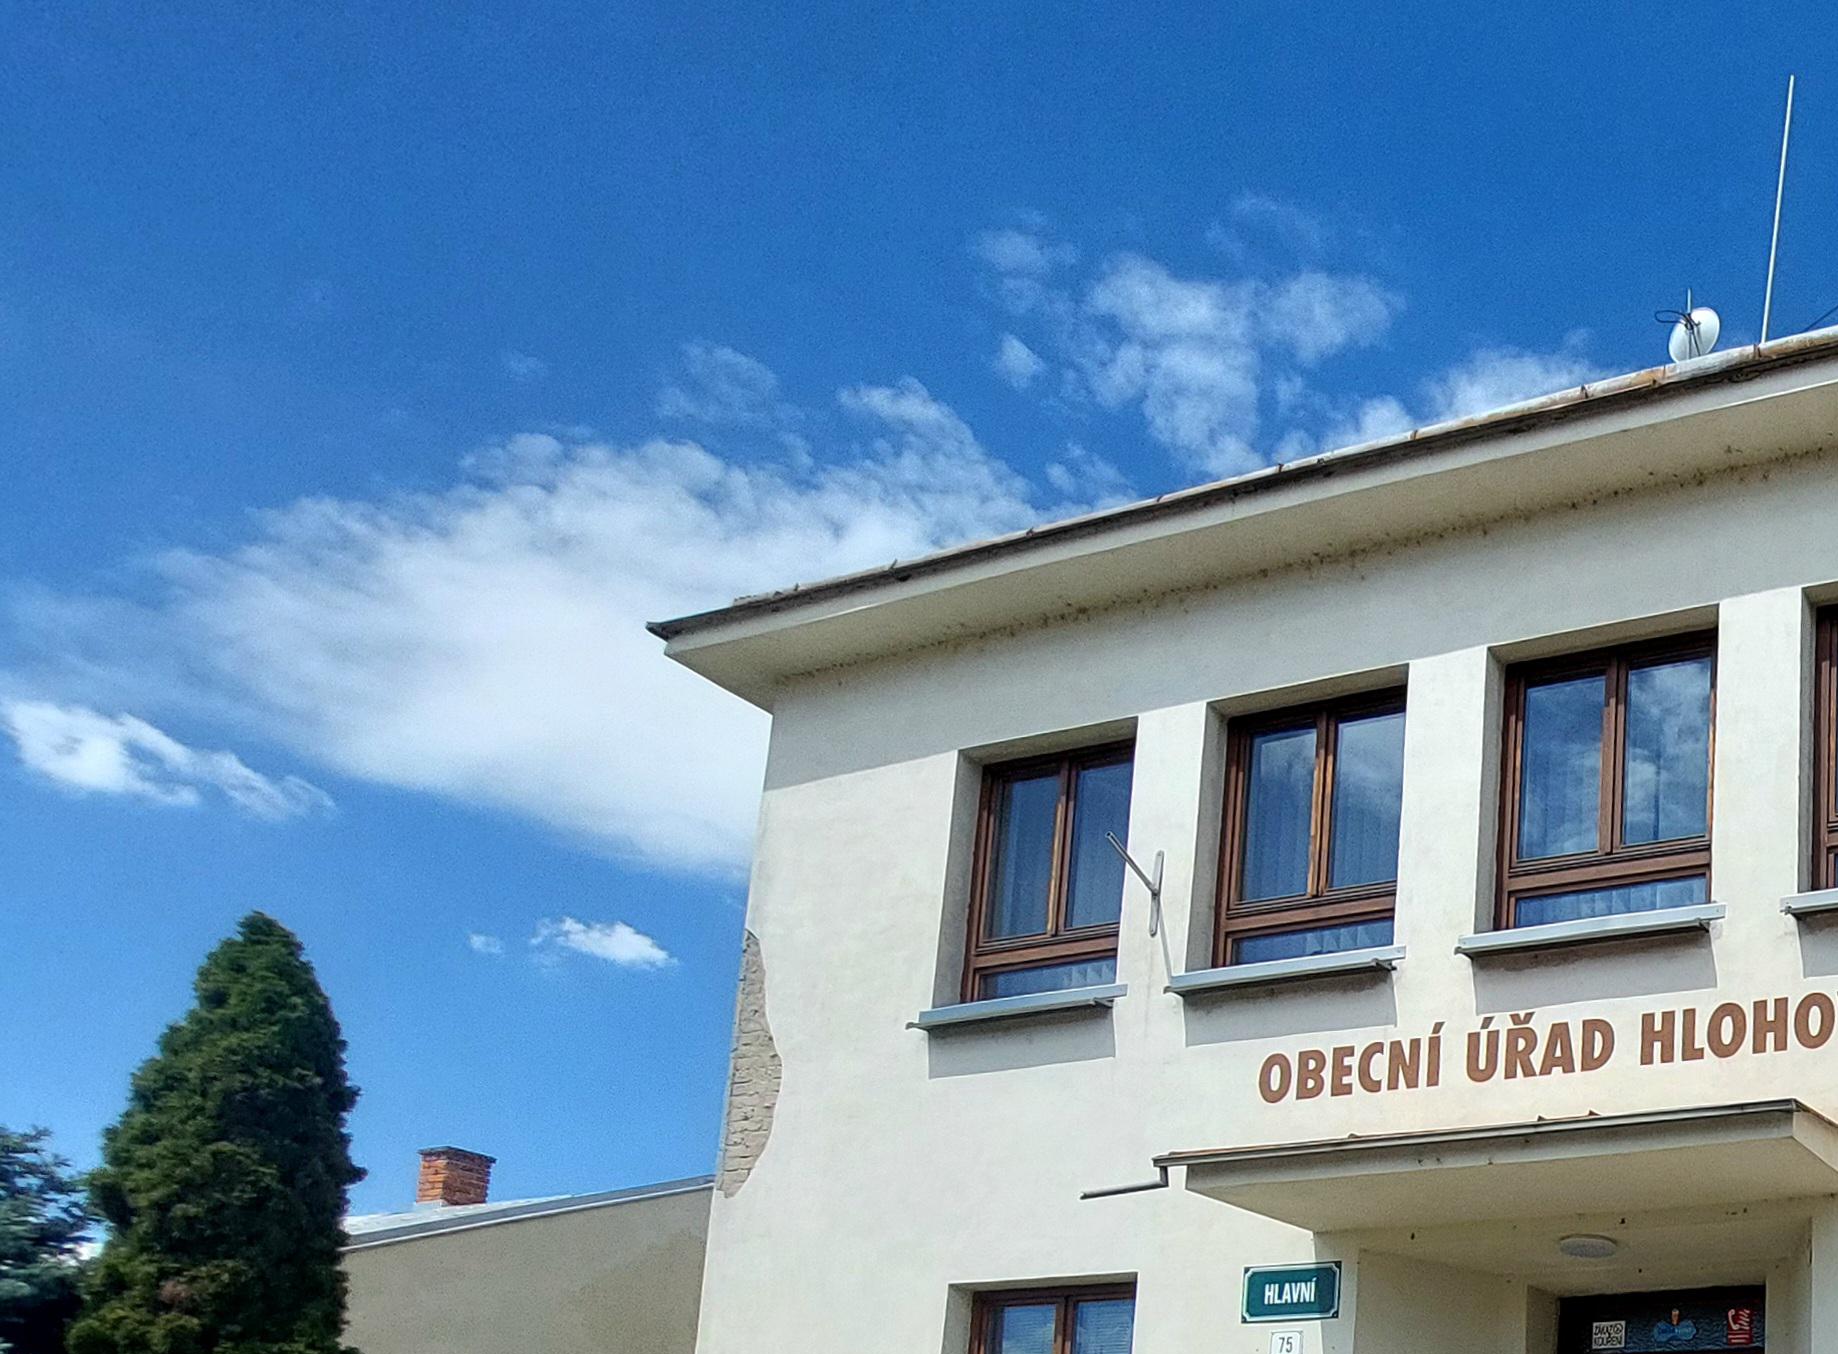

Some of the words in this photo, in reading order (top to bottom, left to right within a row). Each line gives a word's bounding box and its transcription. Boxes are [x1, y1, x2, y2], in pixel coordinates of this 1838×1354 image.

[1258, 1021, 1445, 1104] OBECNÍ
[1466, 1011, 1616, 1082] ÚŘAD
[1263, 1276, 1317, 1305] HLAVNÍ
[1278, 1336, 1293, 1354] 75
